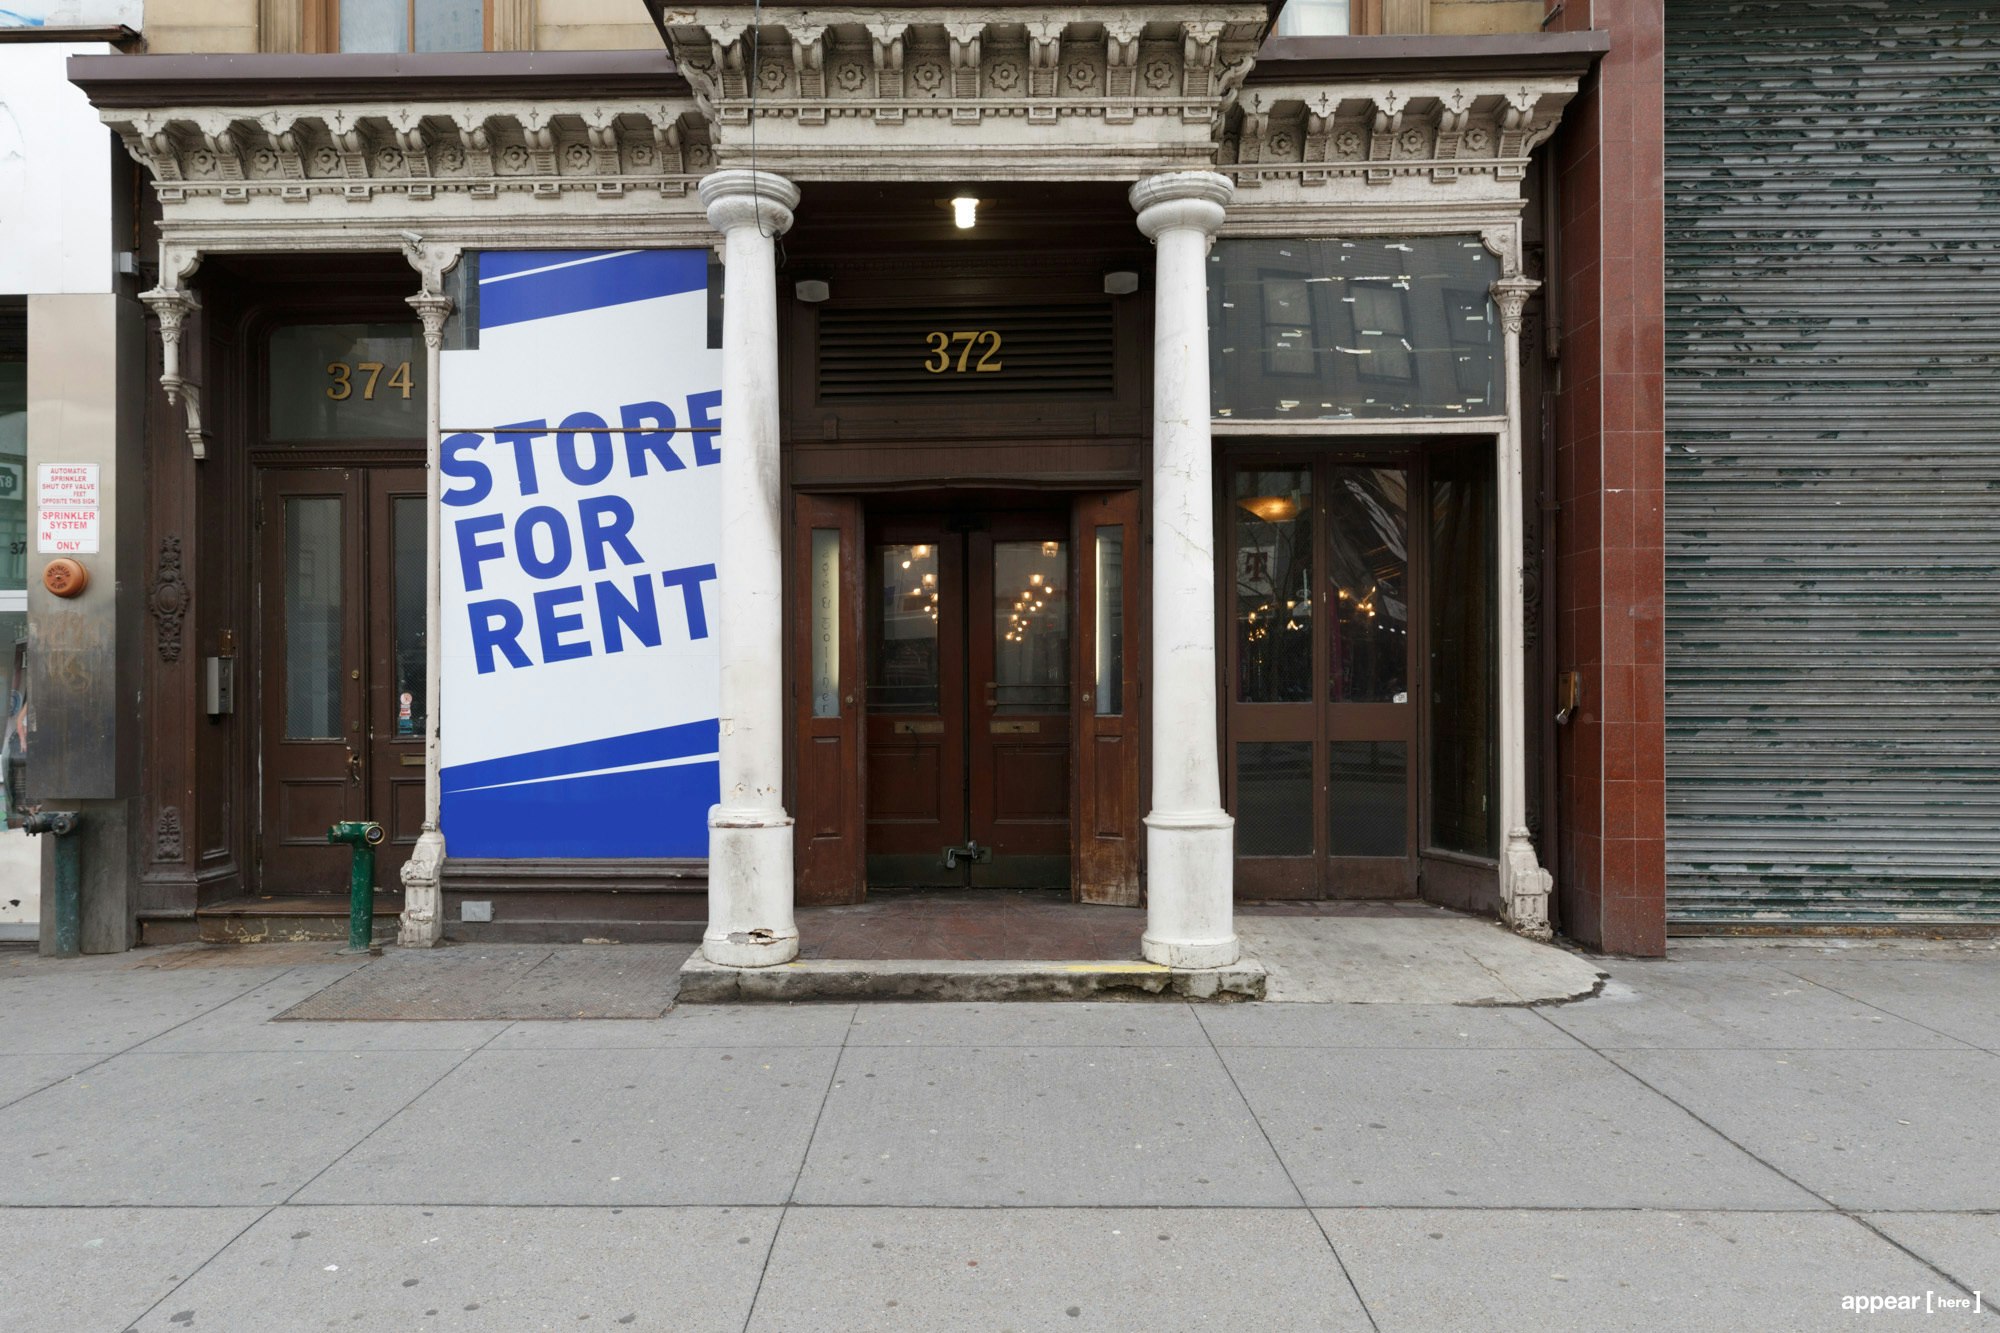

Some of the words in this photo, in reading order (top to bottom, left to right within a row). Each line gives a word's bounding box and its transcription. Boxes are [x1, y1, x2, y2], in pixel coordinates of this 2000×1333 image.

[924, 330, 1003, 373] 372
[326, 362, 415, 400] 374
[440, 390, 722, 507] STORE
[42, 511, 95, 520] SPRINKLER
[50, 521, 87, 529] SYSTEM
[10, 541, 27, 555] 37
[42, 532, 52, 540] IN
[56, 541, 81, 550] ONLY
[454, 495, 645, 592] FOR
[467, 563, 717, 675] RENT
